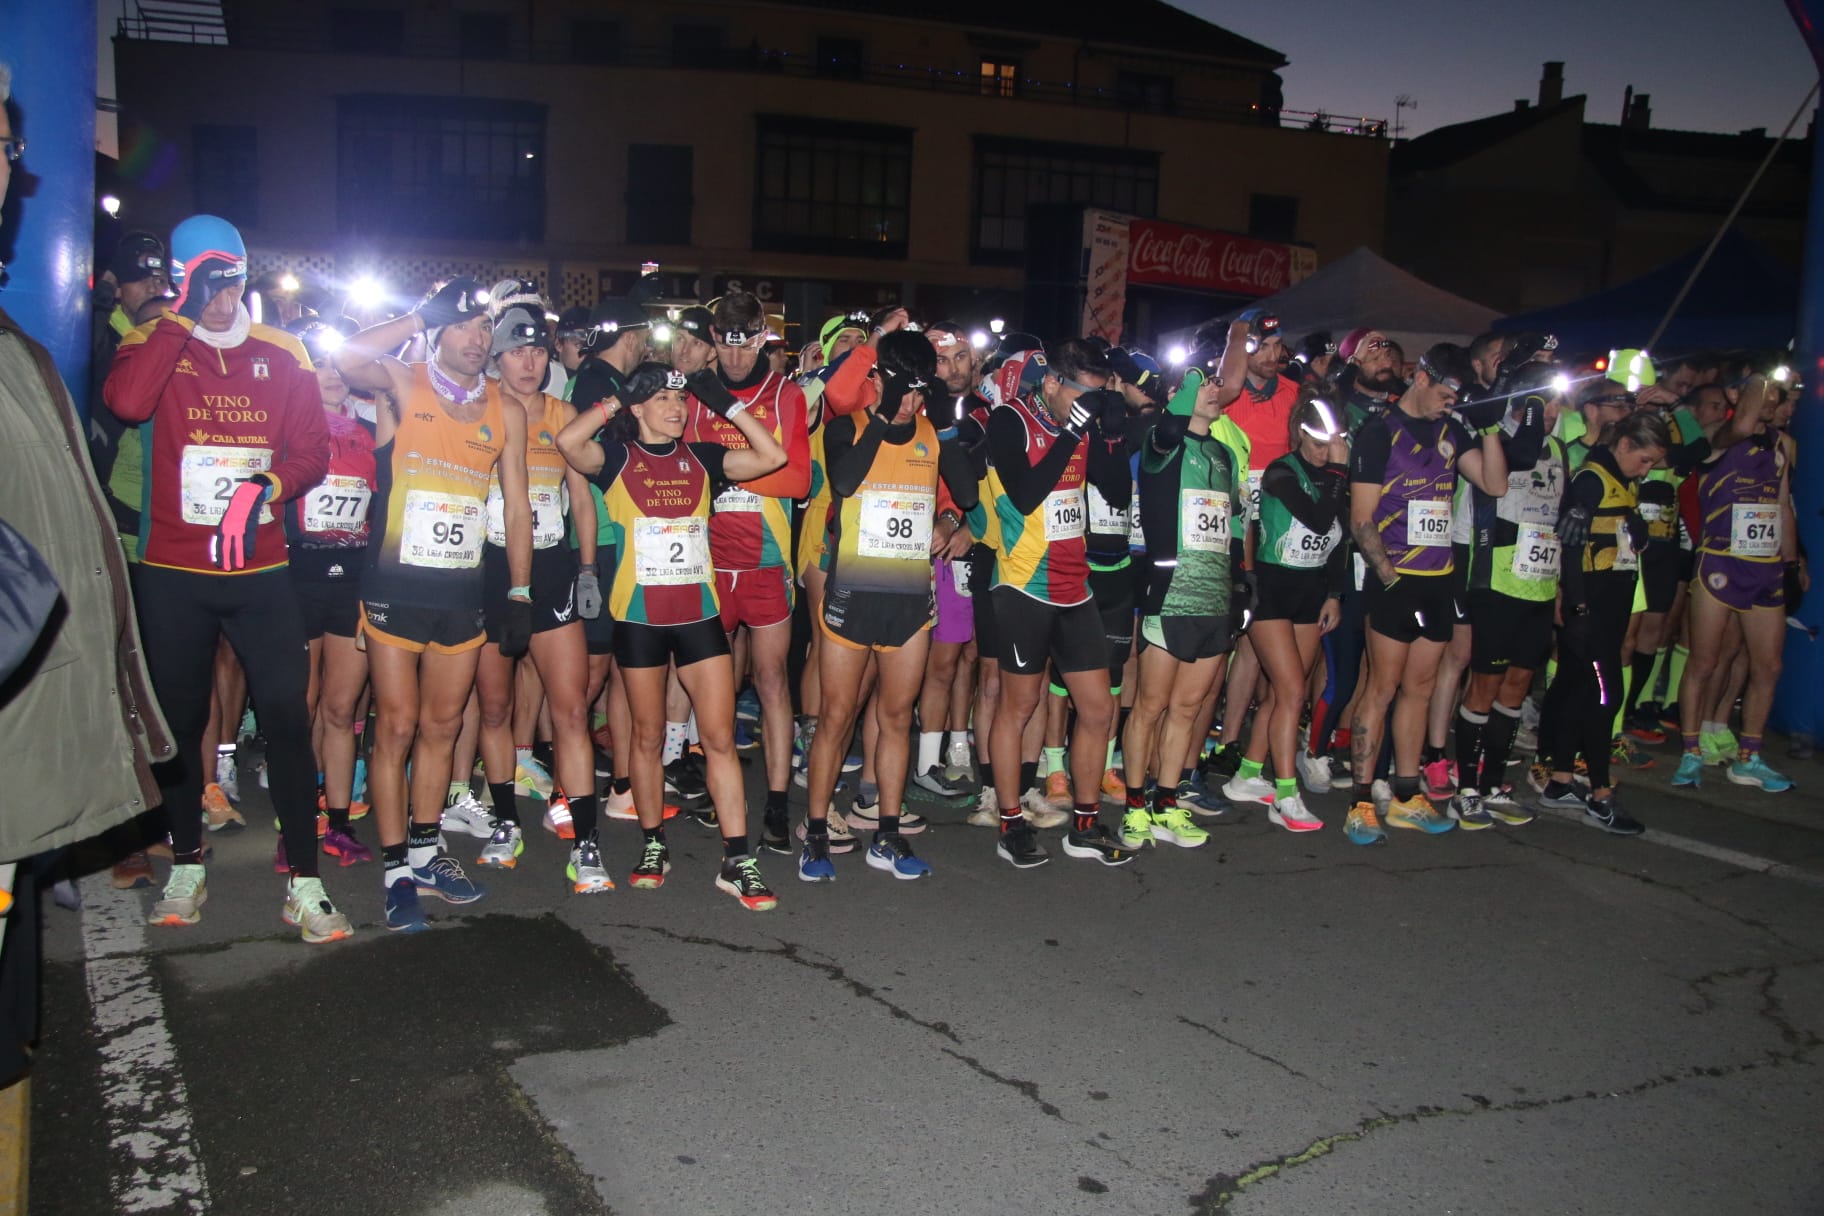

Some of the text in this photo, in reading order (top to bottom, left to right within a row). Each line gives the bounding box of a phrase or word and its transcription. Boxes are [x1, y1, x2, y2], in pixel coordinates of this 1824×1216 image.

[203, 395, 250, 408] VINO
[187, 407, 268, 423] DE TORO
[237, 435, 269, 444] RURAL
[655, 489, 681, 497] VINO
[194, 503, 206, 515] 32
[318, 494, 362, 517] 277
[420, 501, 479, 517] JOMISAGA
[647, 497, 692, 507] DE TORO
[1054, 507, 1082, 525] 1094
[1198, 513, 1226, 534] 341
[433, 521, 465, 546] 95
[647, 524, 701, 535] JOMISAGA
[886, 517, 913, 539] 98
[1418, 518, 1449, 533] 1057
[1747, 523, 1776, 540] 674
[411, 545, 424, 557] 32
[868, 538, 880, 548] 32
[1301, 534, 1331, 552] 658
[669, 542, 685, 563] 2
[1528, 545, 1557, 565] 547
[645, 567, 657, 577] 32
